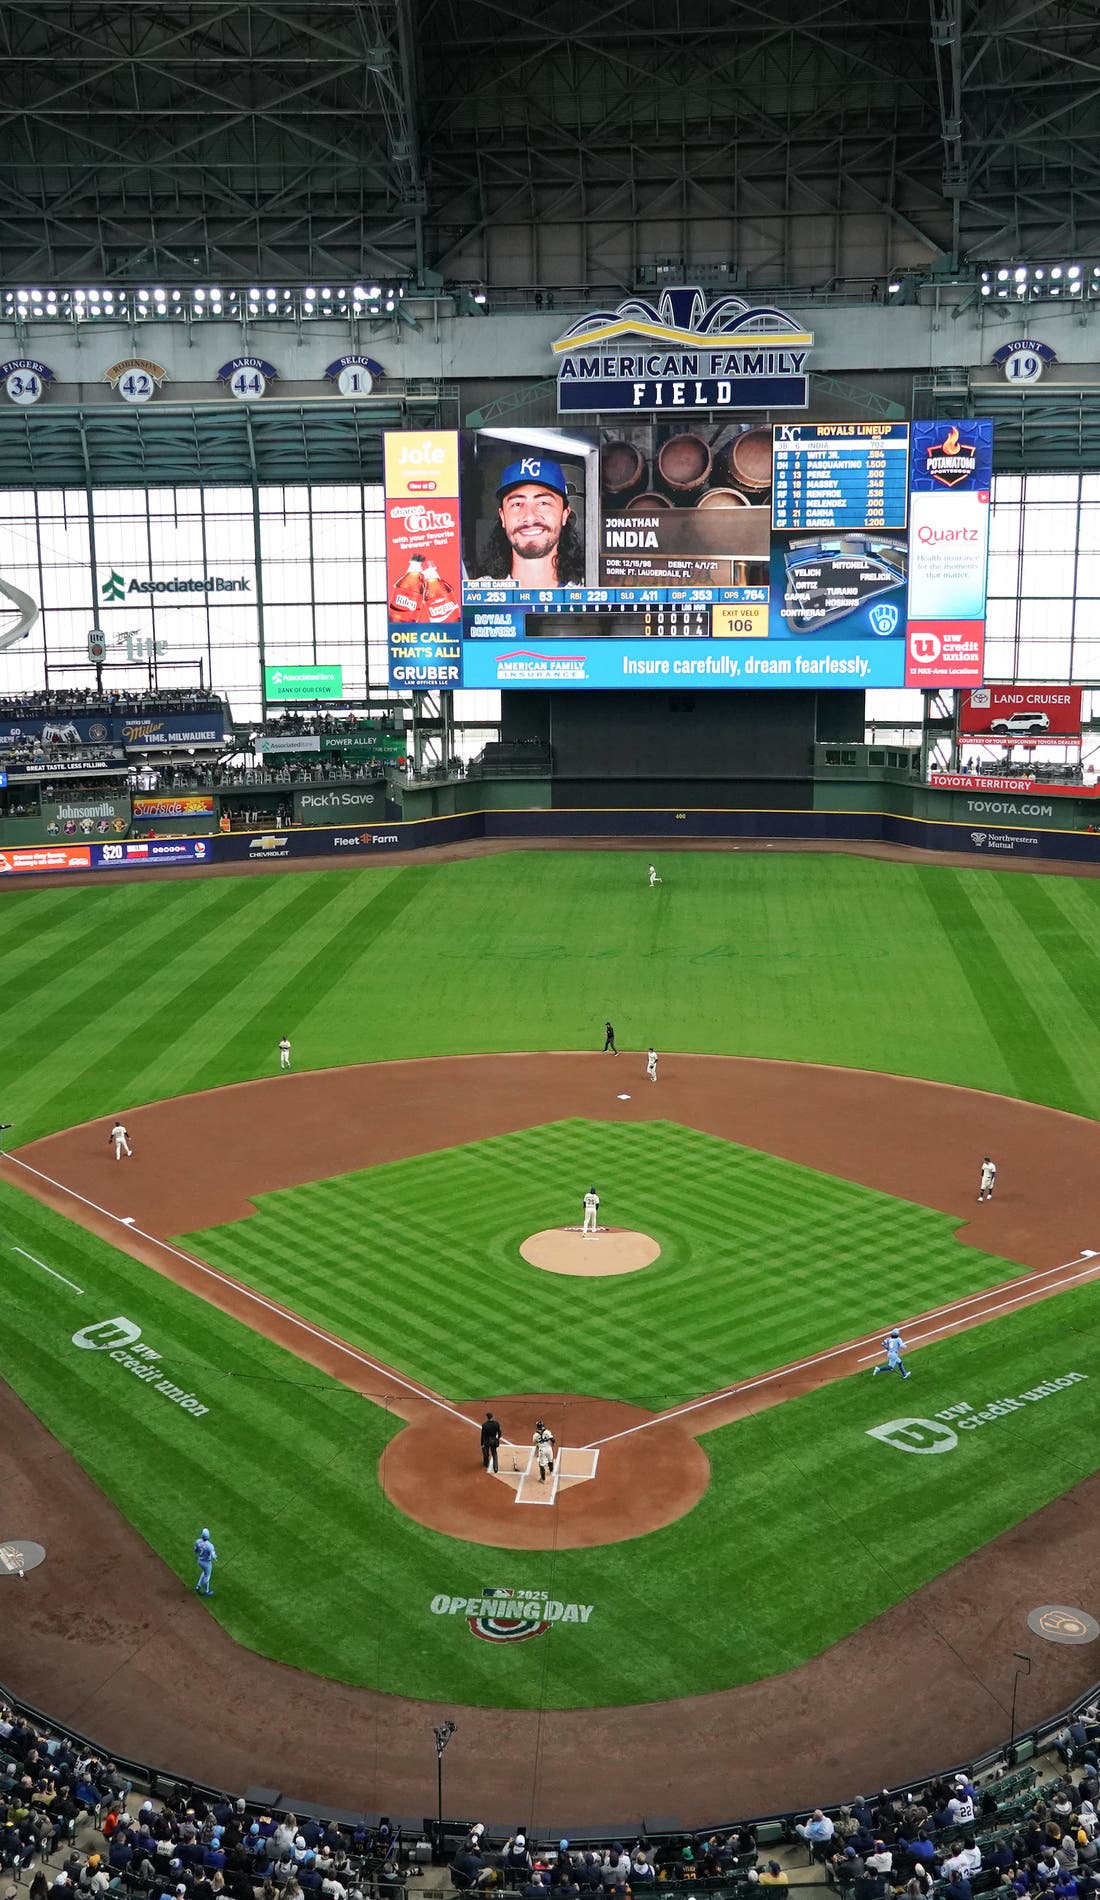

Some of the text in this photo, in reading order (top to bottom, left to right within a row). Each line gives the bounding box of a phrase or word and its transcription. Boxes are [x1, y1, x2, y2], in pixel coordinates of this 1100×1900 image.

[1008, 341, 1042, 352] YOUNT
[2, 359, 44, 373] FINGERS
[232, 357, 263, 369] AARON
[340, 356, 369, 367] SELIG
[560, 352, 806, 378] AMERICAN FAMILY
[1011, 358, 1038, 378] 19
[11, 376, 38, 395] 34
[123, 376, 149, 394] 42
[234, 374, 260, 393] 44
[351, 374, 361, 392] 1
[633, 381, 732, 405] FIELD
[817, 426, 892, 436] ROYALS LINEUP
[397, 441, 446, 465] Joie
[807, 452, 827, 460] WITT
[927, 457, 976, 471] POTAWATOMI
[404, 511, 455, 532] Coke
[606, 518, 659, 528] JONATHAN
[606, 531, 659, 548] INDIA
[918, 526, 978, 545] Quartz
[668, 561, 693, 569] DEBUT:
[832, 561, 870, 569] MITCHELL
[794, 569, 821, 577] YELICH
[795, 581, 818, 589] ORTIZ
[467, 593, 482, 601] AVG
[689, 589, 712, 601] .353
[474, 614, 512, 625] ROYALS
[780, 609, 826, 617] CONTRERAS
[728, 620, 752, 632] 106
[391, 633, 418, 643] ONE
[391, 647, 460, 658] THAT'S ALL!
[943, 641, 978, 651] credit
[943, 652, 979, 661] union
[498, 662, 585, 671] AMERICAN FAMILY
[623, 654, 872, 677] Insure carefully, dream fearlessly.
[393, 666, 459, 680] GRUBER
[994, 693, 1071, 705] LAND CRUISER
[122, 721, 165, 742] Miller
[145, 731, 216, 743] TIME, MILWAUKEE
[326, 739, 353, 747] POWER
[933, 776, 1031, 790] TOYOTA TERRITORY
[301, 793, 374, 808] Pick Save
[57, 802, 115, 820] Johnsonville
[133, 800, 182, 817] Surfside
[967, 800, 1053, 817] TOYOTA.COM
[334, 834, 398, 846] Fleet Farm
[988, 834, 1038, 845] Northwestern
[103, 844, 122, 860] $20
[249, 850, 290, 858] CHEVROLET
[130, 1343, 163, 1361] uw
[109, 1350, 210, 1417] credit union
[958, 1371, 1089, 1430] credit union
[935, 1401, 974, 1421] uw
[517, 1590, 549, 1600] 2025
[430, 1594, 594, 1623] OPENING DAY
[960, 1805, 972, 1817] 22
